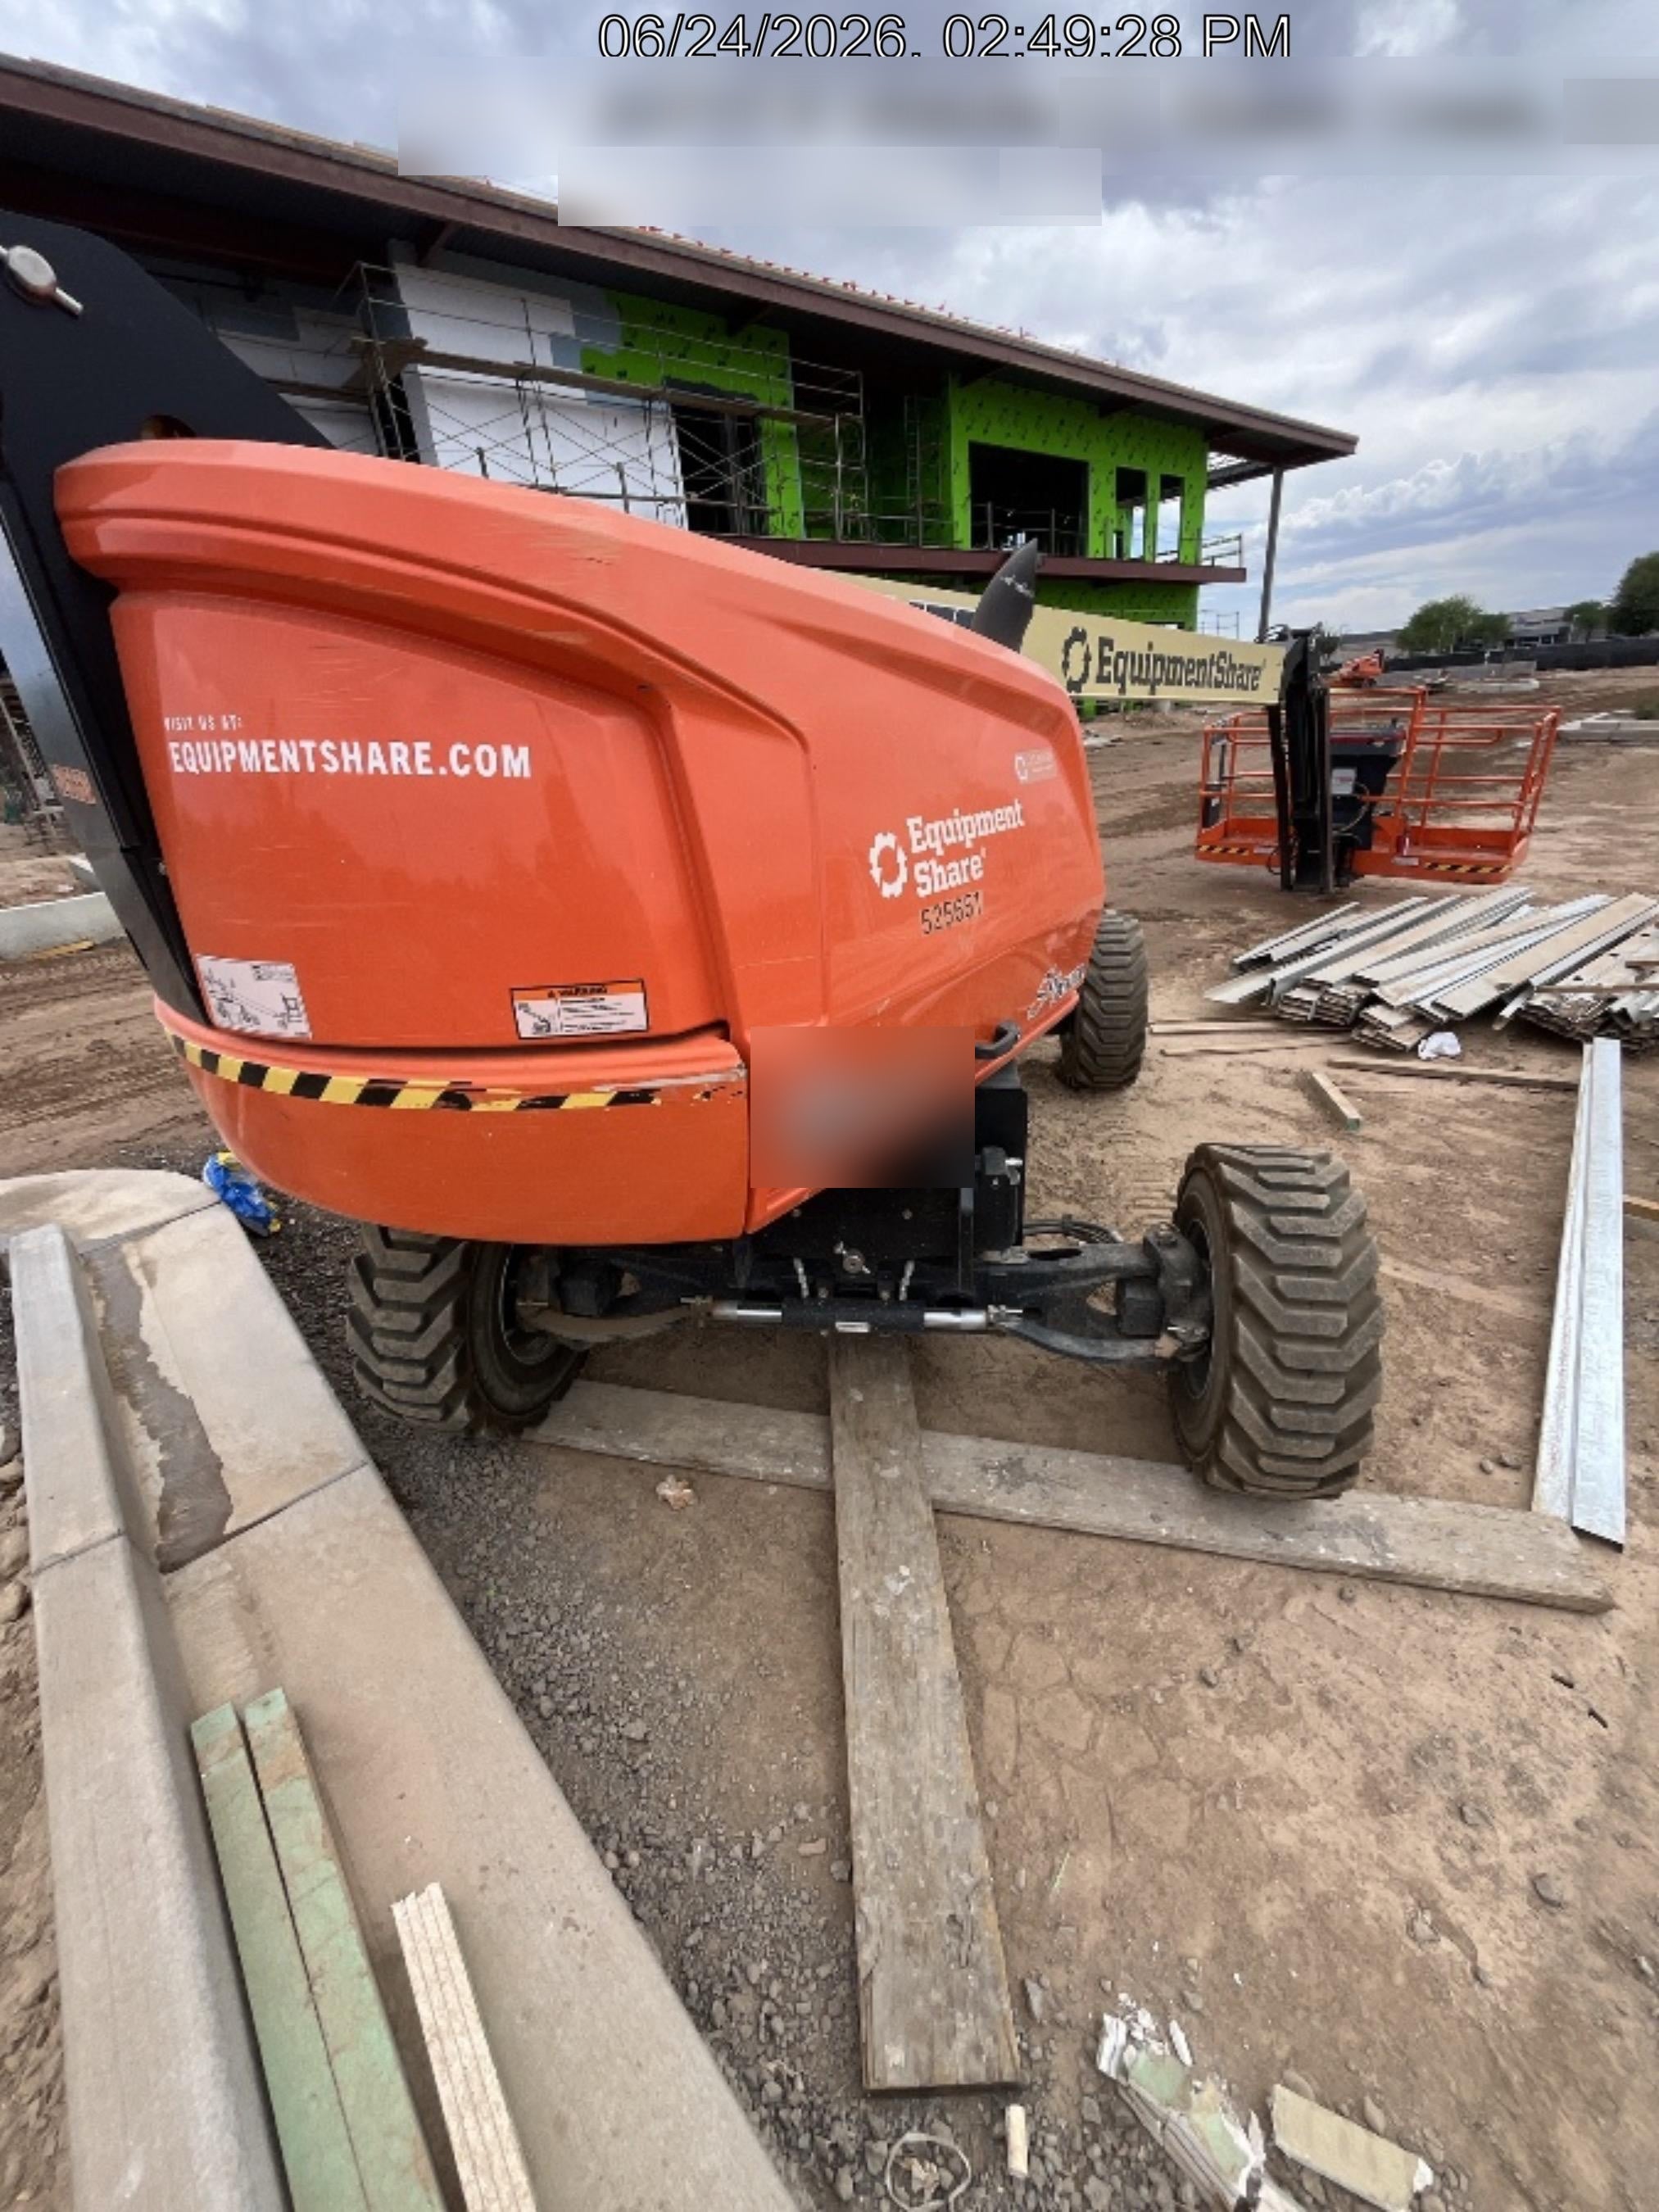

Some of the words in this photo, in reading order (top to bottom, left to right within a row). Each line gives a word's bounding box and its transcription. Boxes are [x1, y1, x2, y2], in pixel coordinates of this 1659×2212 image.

[1095, 637, 1262, 695] EquipmentShare
[168, 740, 531, 779] EQUIPMENTSHARE.COM
[907, 799, 1025, 856] Equipment
[913, 854, 984, 898] Share
